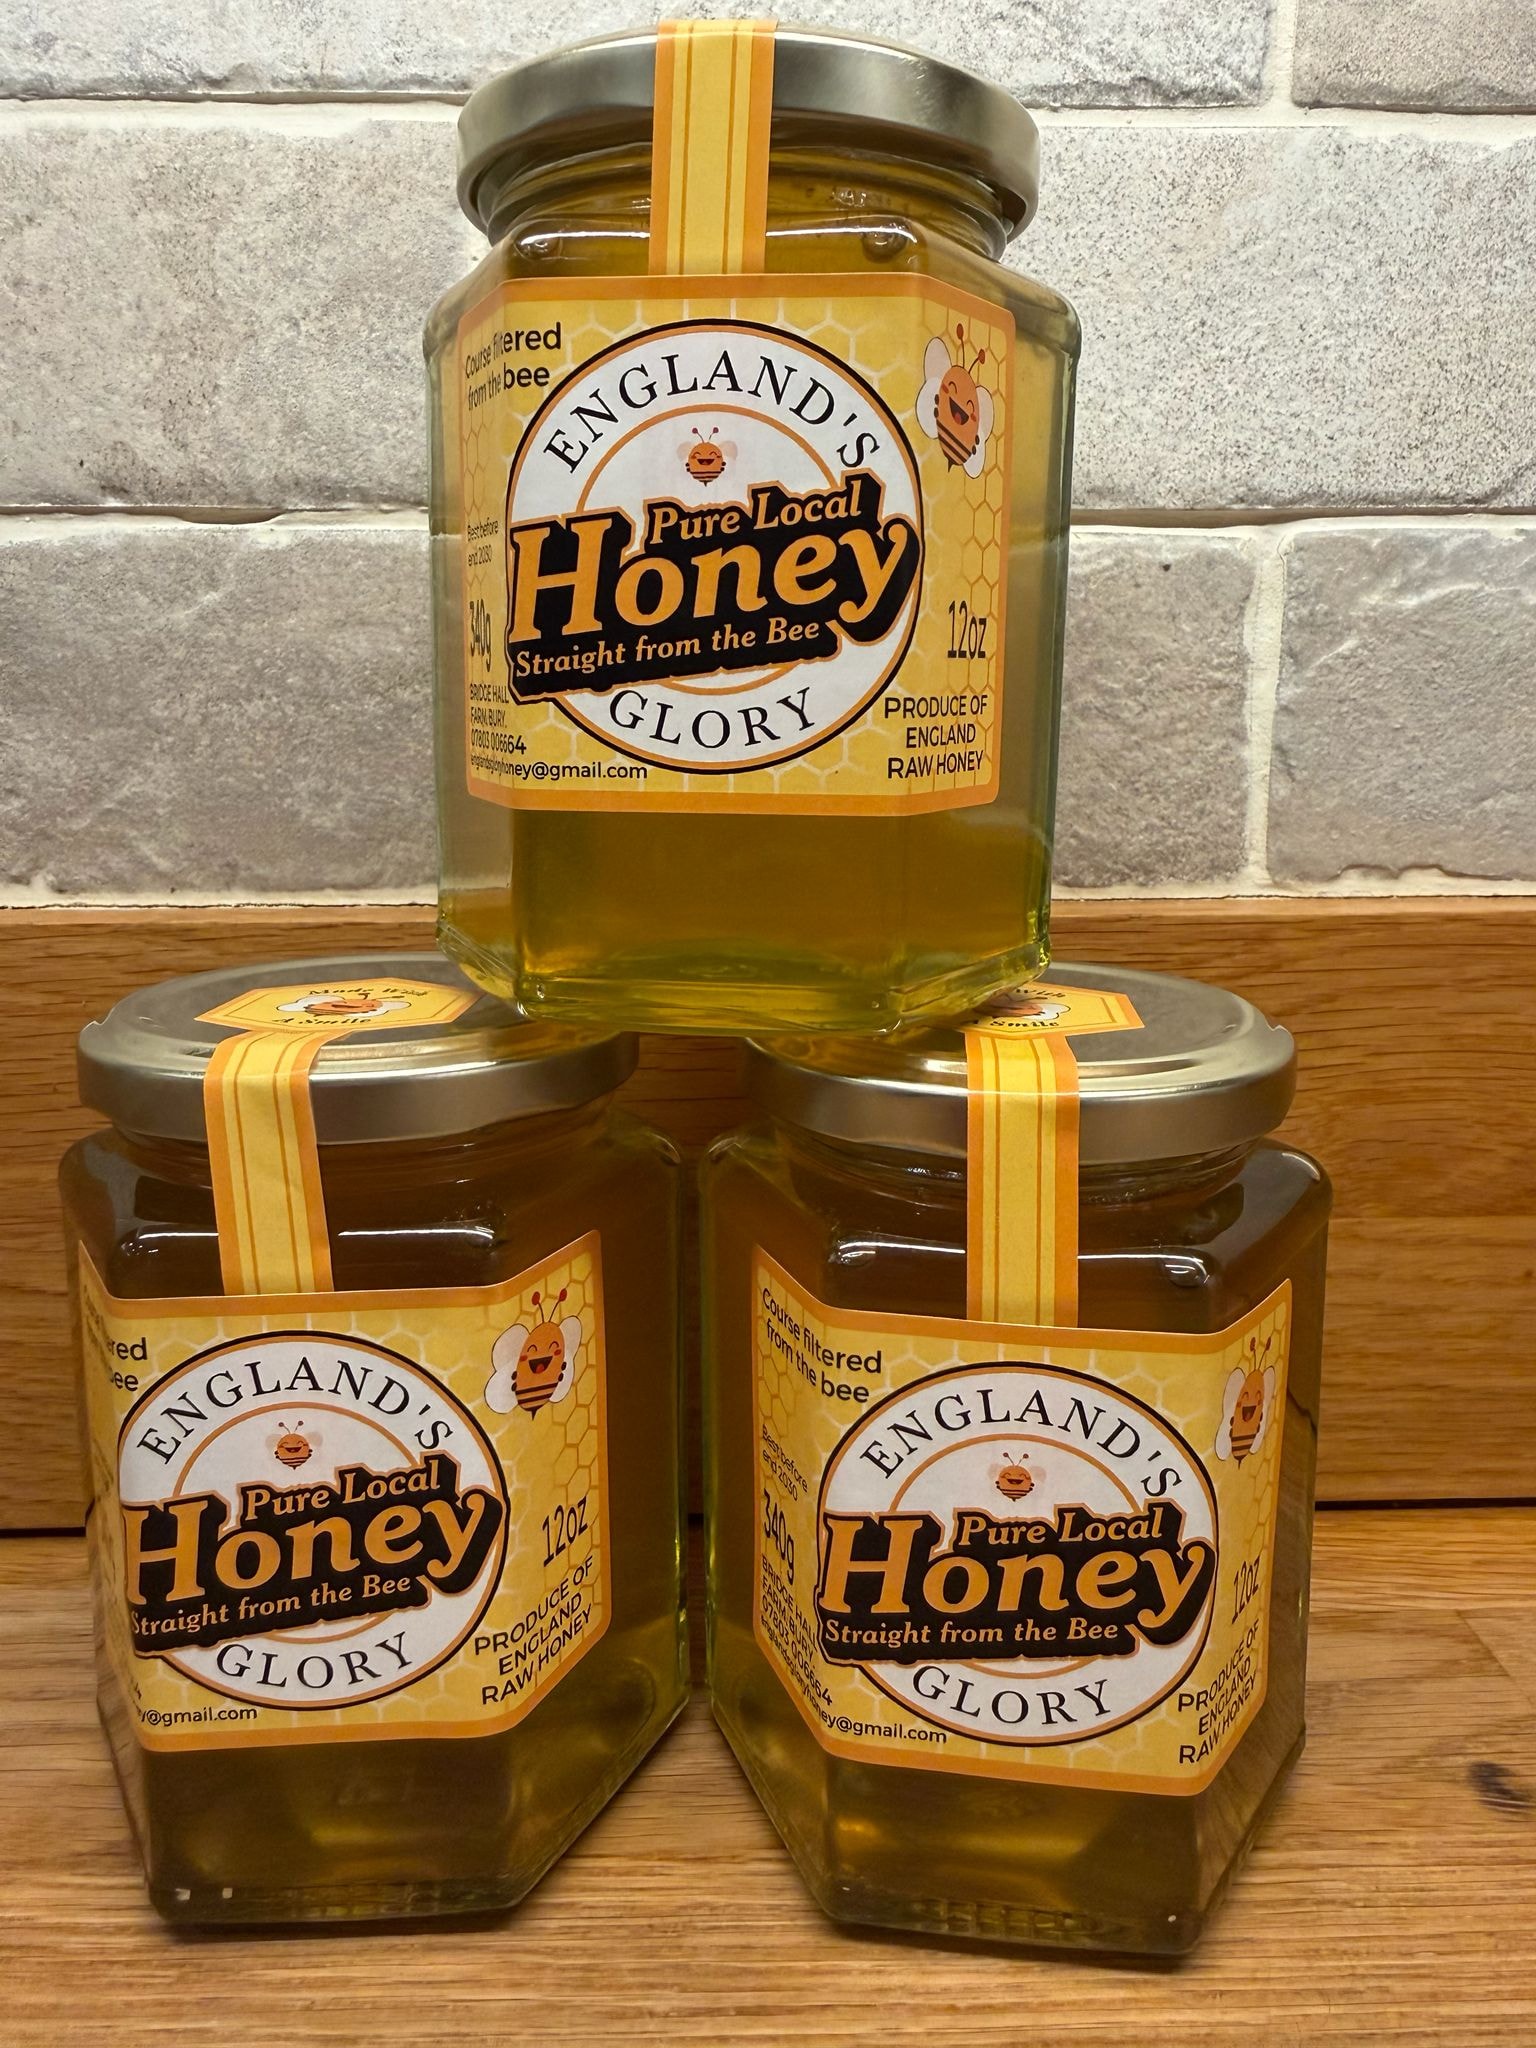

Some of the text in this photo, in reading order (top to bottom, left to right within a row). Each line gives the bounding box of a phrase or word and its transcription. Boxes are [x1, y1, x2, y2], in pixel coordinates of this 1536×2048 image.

[468, 384, 487, 411] from
[503, 362, 550, 390] bee
[543, 350, 880, 474] ENGLAND'S
[649, 480, 862, 545] Pure Local
[508, 518, 909, 642] Honey
[469, 598, 491, 673] 340g
[515, 617, 820, 678] Straight from the Bee
[947, 600, 987, 660] 12oz
[608, 686, 816, 748] GLORY
[884, 694, 988, 719] PRODUCE OF
[906, 723, 976, 749] ENGLAND
[887, 750, 983, 779] RAW HONEY
[762, 1287, 882, 1374] Course filtered
[766, 1317, 870, 1403] from the bee
[136, 1356, 454, 1465] ENGLAND'S
[859, 1388, 1182, 1498] ENGLAND'S
[244, 1459, 441, 1521] Pure Local
[958, 1506, 1162, 1547] Pure Local
[123, 1494, 486, 1605] Honey
[542, 1496, 588, 1567] 12oz
[763, 1487, 794, 1586] 340g
[131, 1573, 411, 1636] Straight from the Bee
[475, 1555, 593, 1655] PRODUCE OF
[762, 1555, 794, 1614] BRIDGE
[818, 1518, 1206, 1629] Honey
[1231, 1555, 1261, 1625] 12oz
[216, 1631, 413, 1689] GLORY
[482, 1603, 592, 1705] RAW HONEY
[499, 1592, 582, 1676] ENGLAND
[762, 1595, 833, 1706] 07803 006664
[825, 1616, 1119, 1649] Straight from the Bee
[1178, 1618, 1260, 1712] PRODUCE OF
[912, 1665, 1111, 1725] GLORY
[1179, 1670, 1257, 1764] RAW HONEY
[1199, 1656, 1252, 1736] ENGLAND
